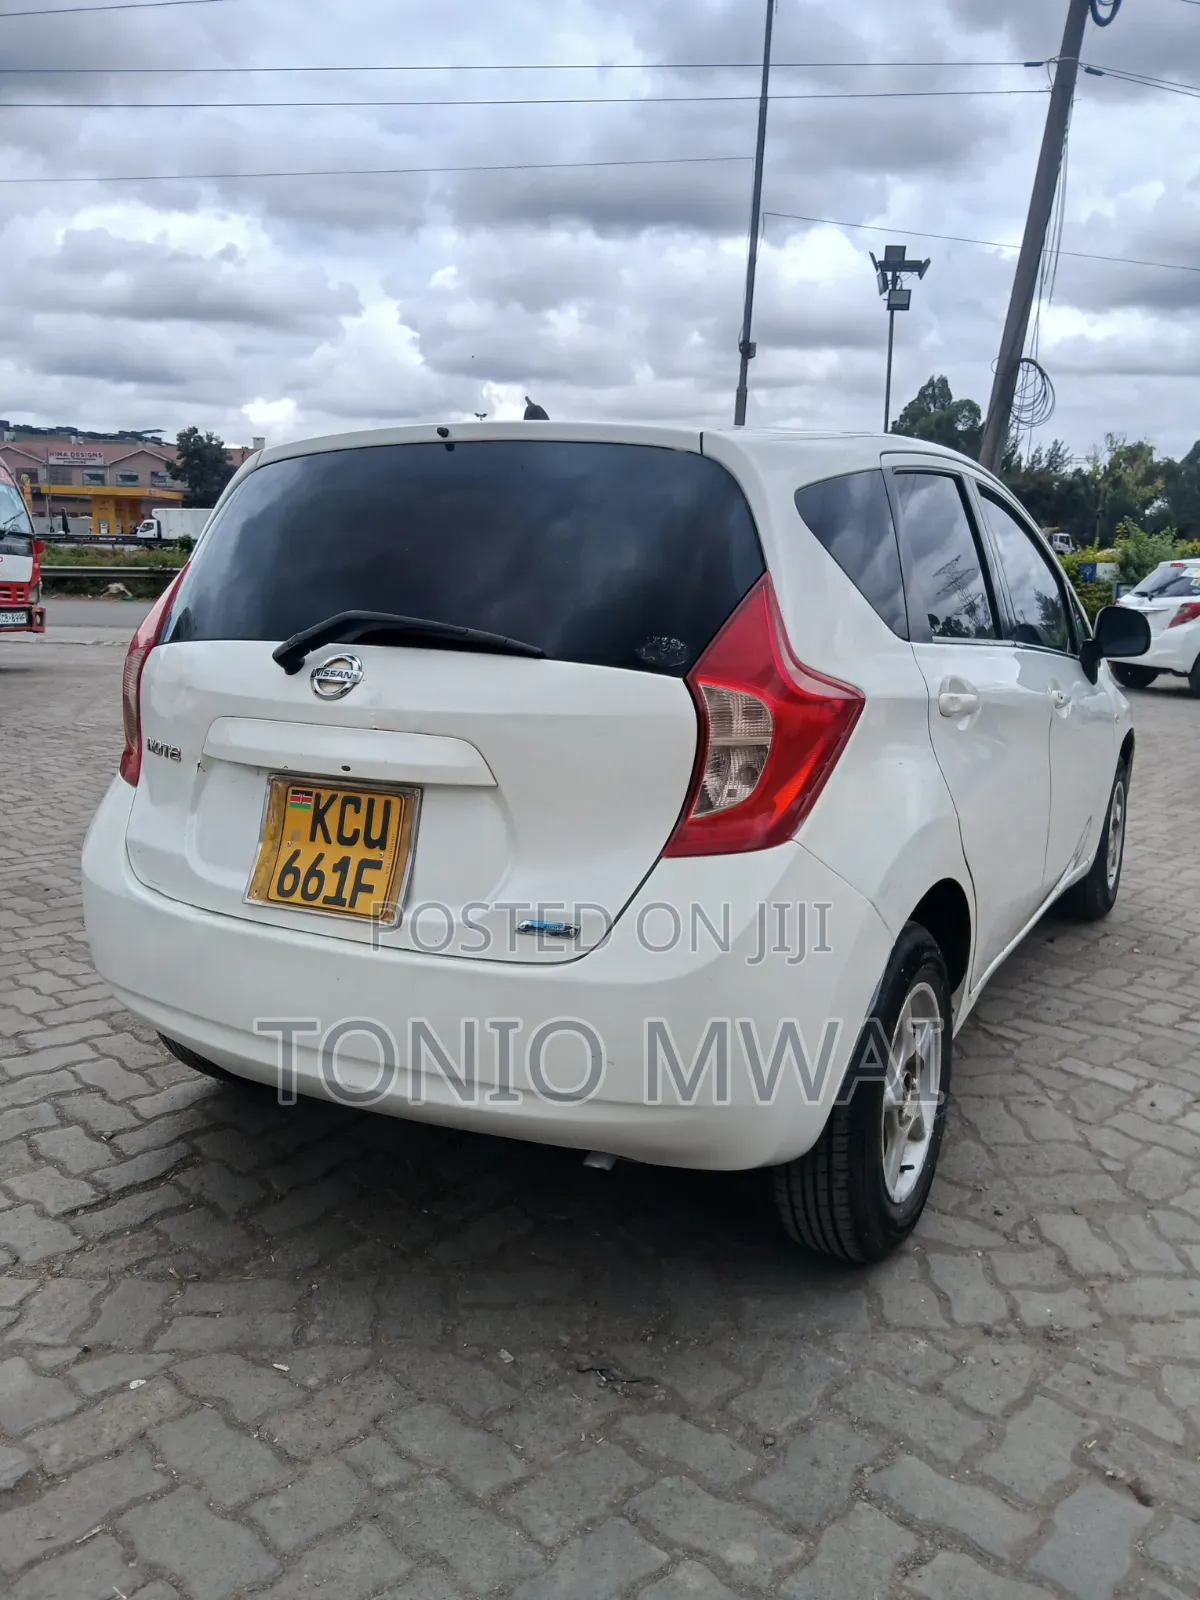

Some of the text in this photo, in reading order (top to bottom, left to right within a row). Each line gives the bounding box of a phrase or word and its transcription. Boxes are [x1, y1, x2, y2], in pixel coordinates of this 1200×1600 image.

[70, 451, 103, 459] DESIGNS
[311, 669, 353, 679] NISSAN
[309, 792, 391, 851] KCU
[276, 849, 383, 909] 661F
